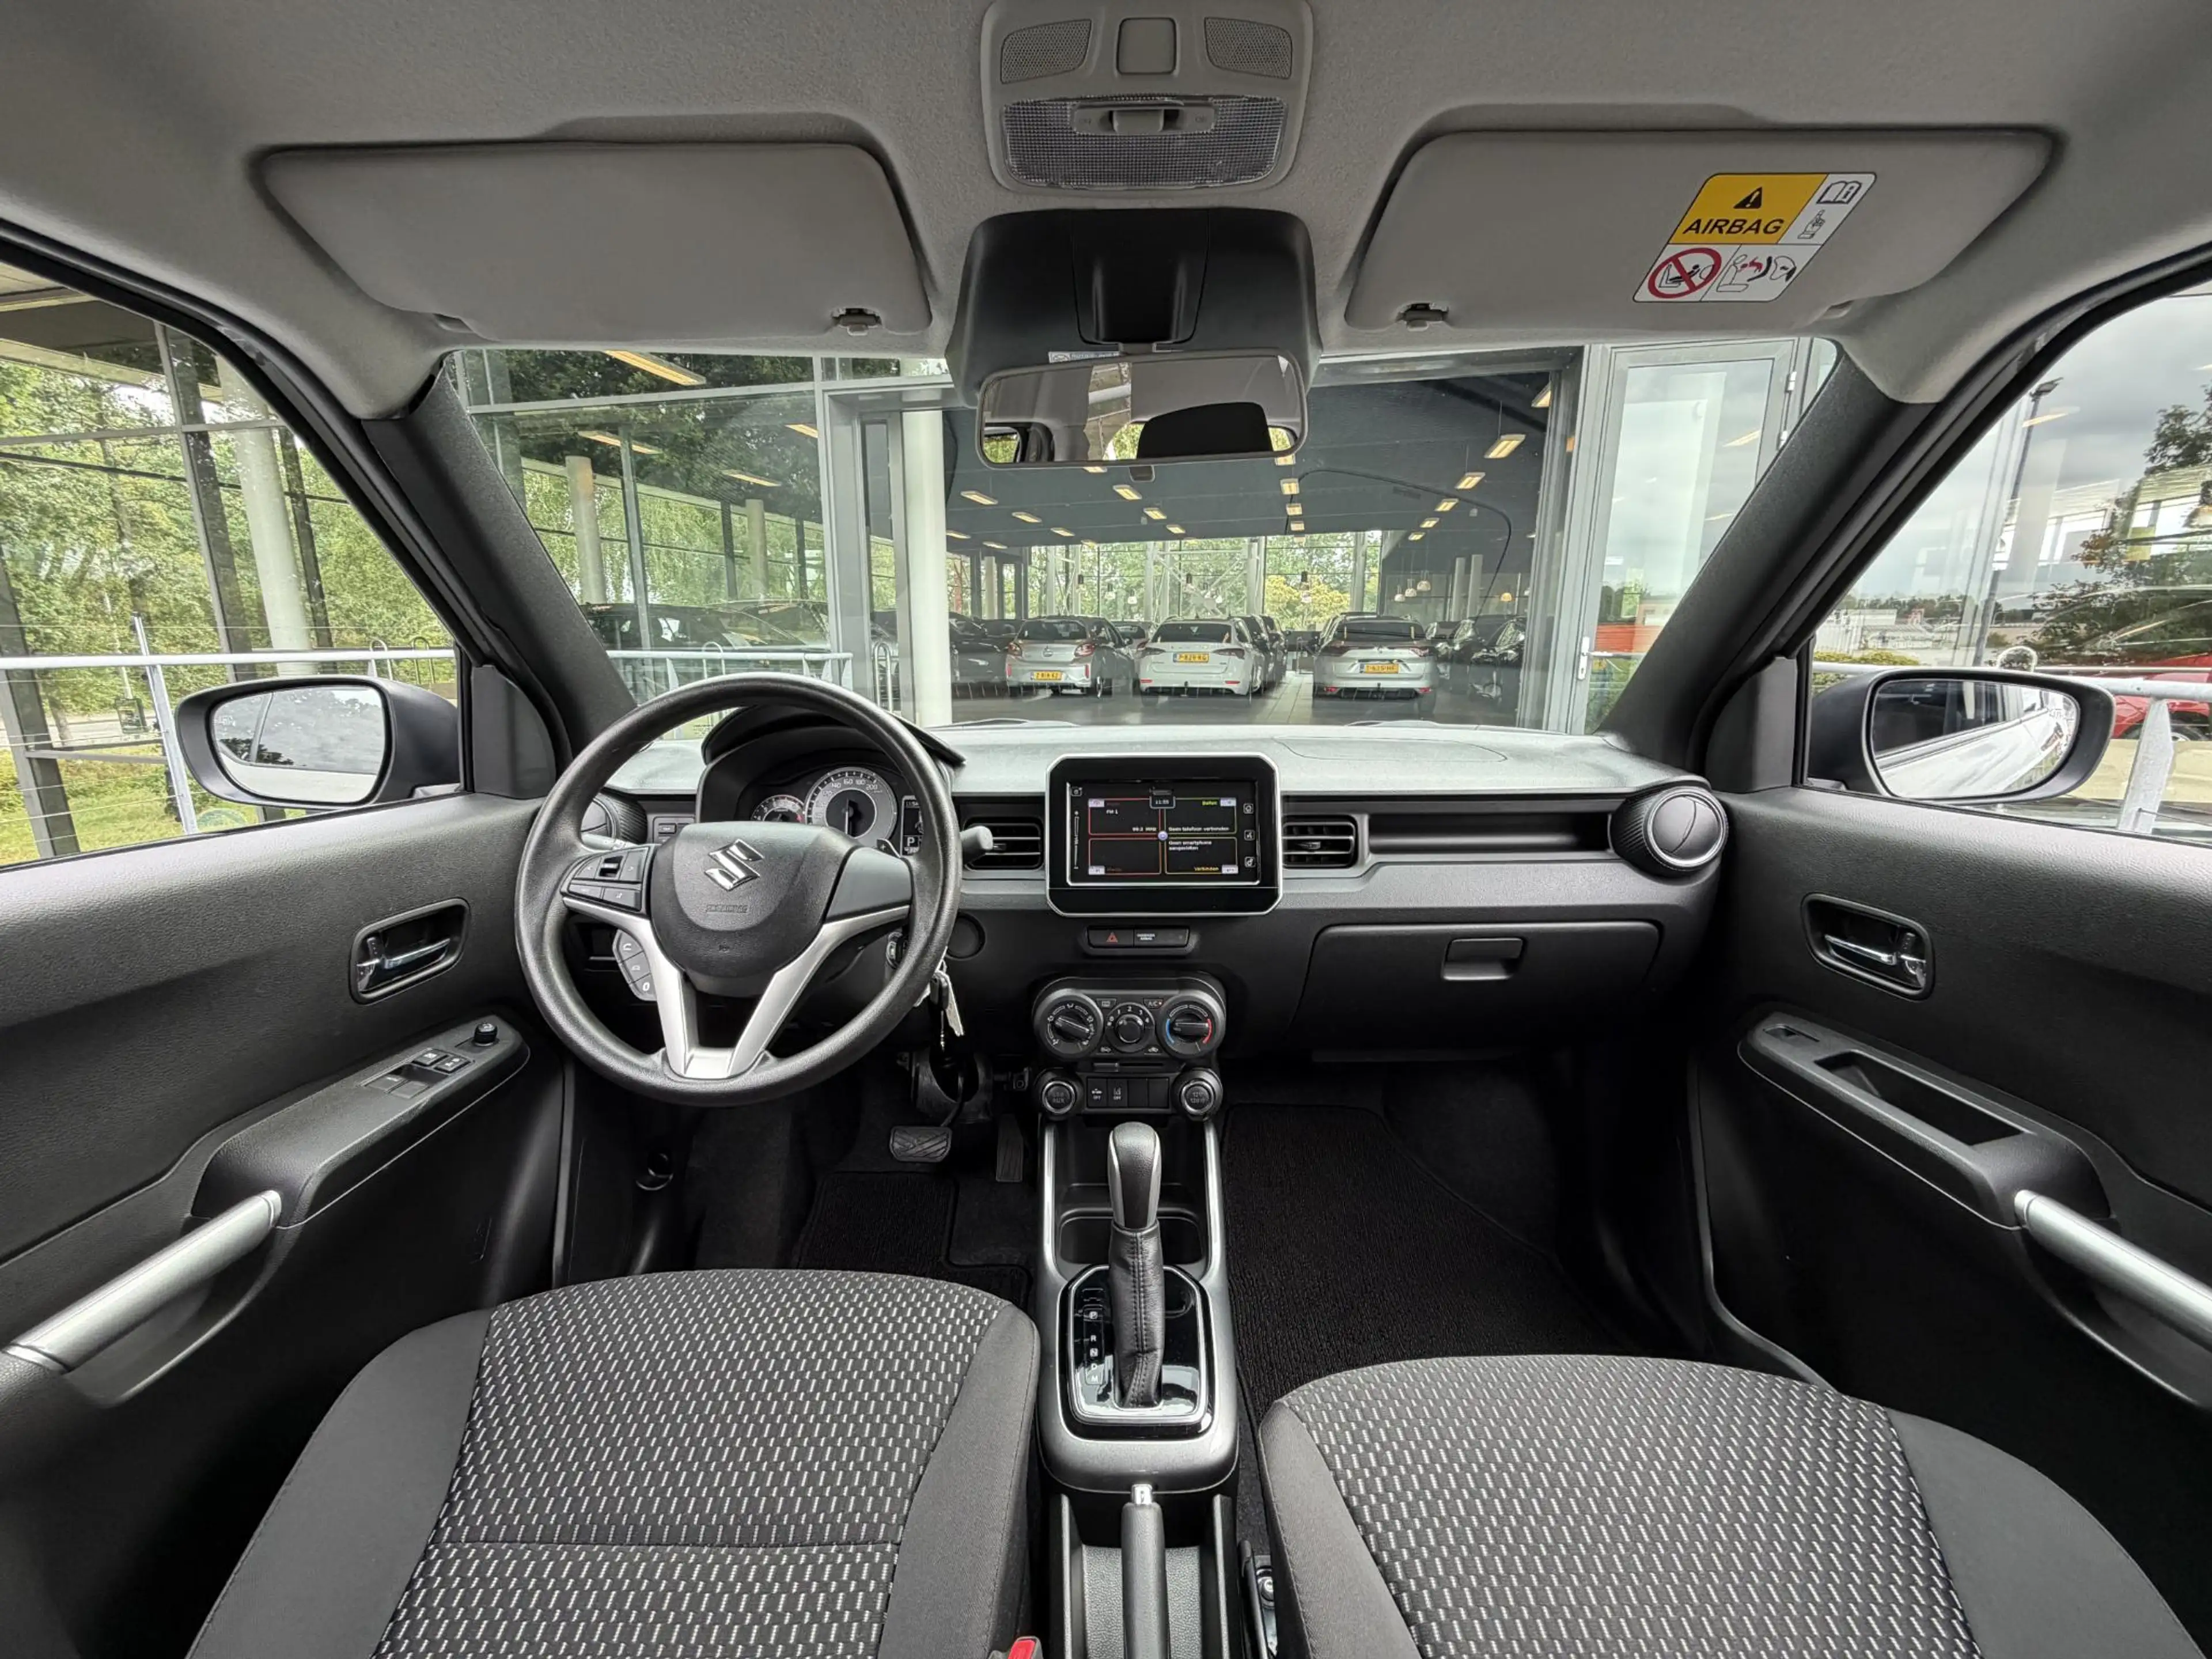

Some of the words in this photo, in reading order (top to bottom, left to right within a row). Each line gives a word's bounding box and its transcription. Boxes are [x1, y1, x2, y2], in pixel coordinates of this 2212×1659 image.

[1682, 218, 1785, 234] AIRBAG
[907, 836, 915, 846] P
[1089, 1311, 1098, 1319] P
[1089, 1348, 1099, 1357] N
